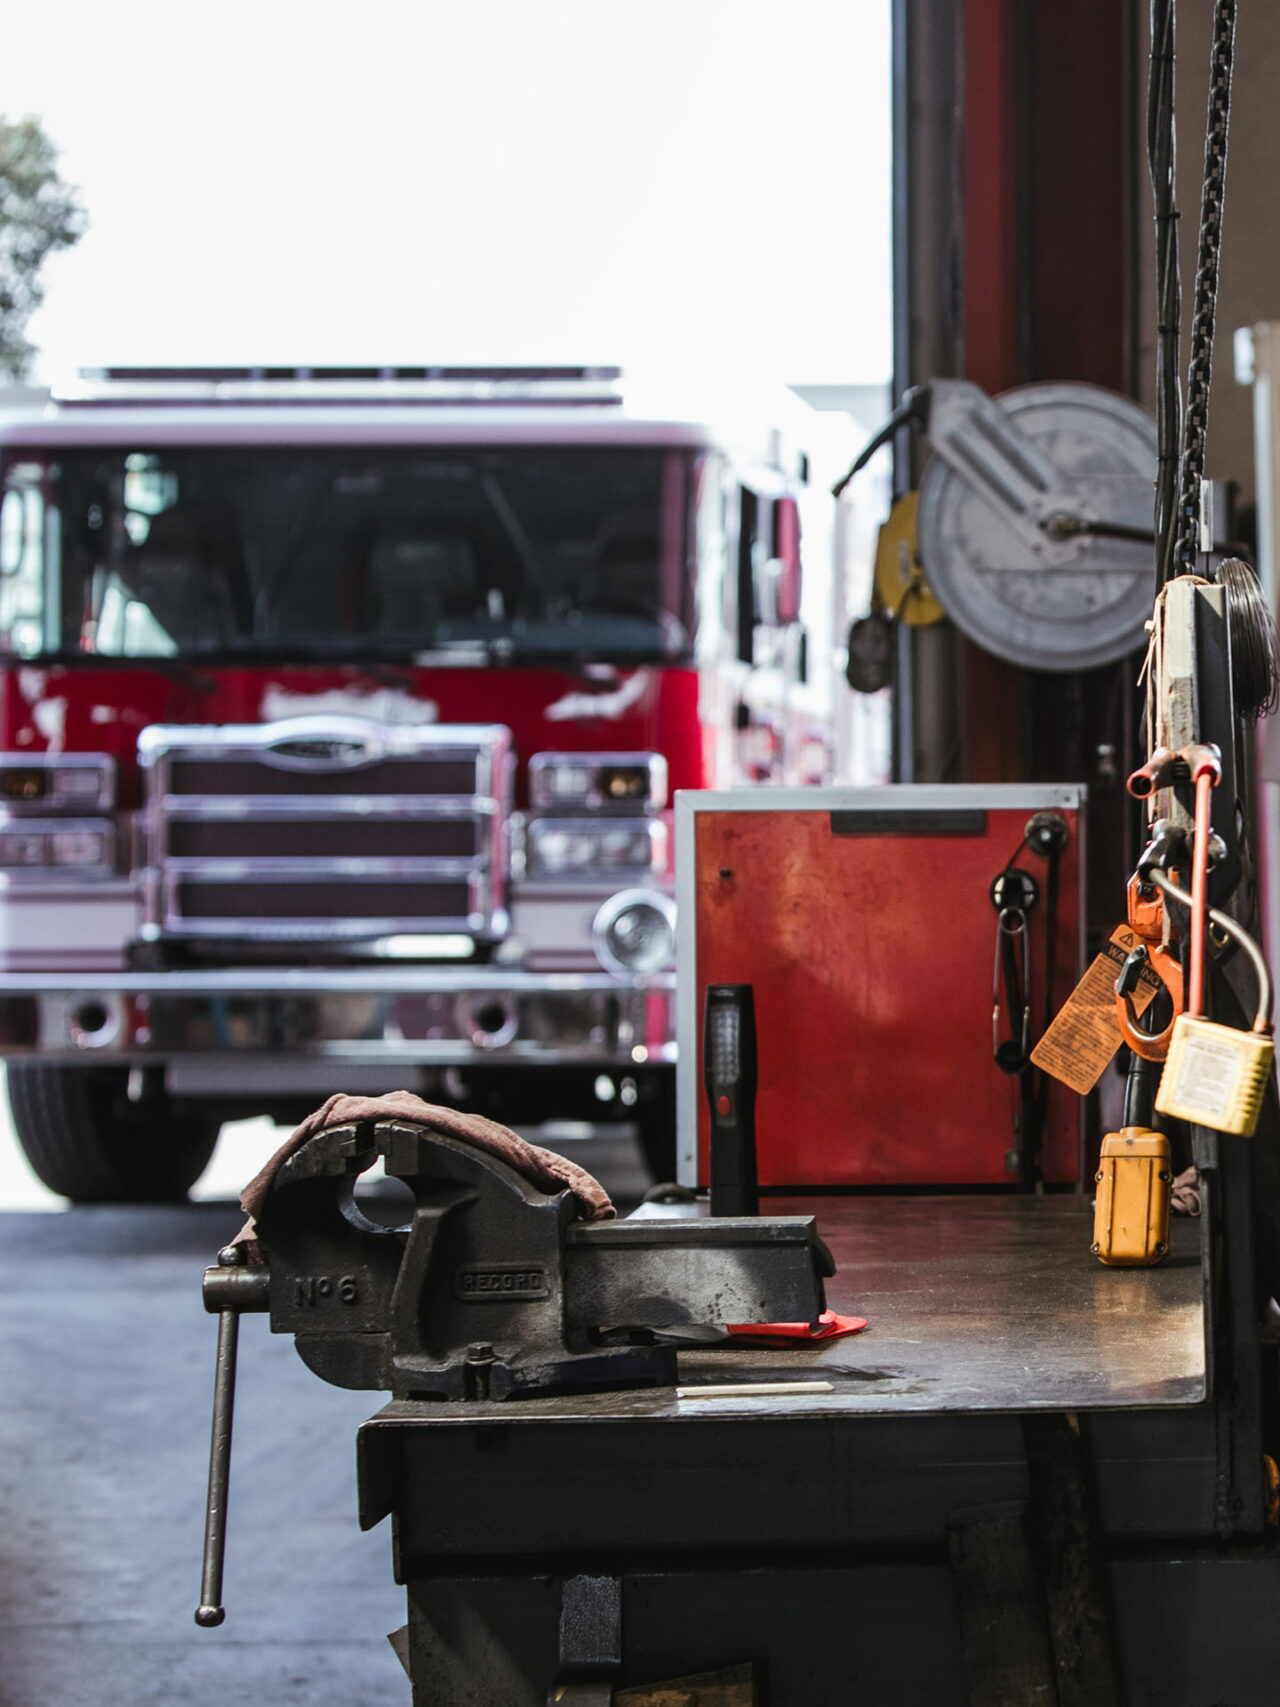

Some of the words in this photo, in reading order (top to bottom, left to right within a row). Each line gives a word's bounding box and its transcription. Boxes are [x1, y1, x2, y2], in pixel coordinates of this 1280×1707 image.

[1105, 944, 1162, 987] WAING
[340, 1275, 357, 1304] 6
[463, 1272, 543, 1291] RECORD
